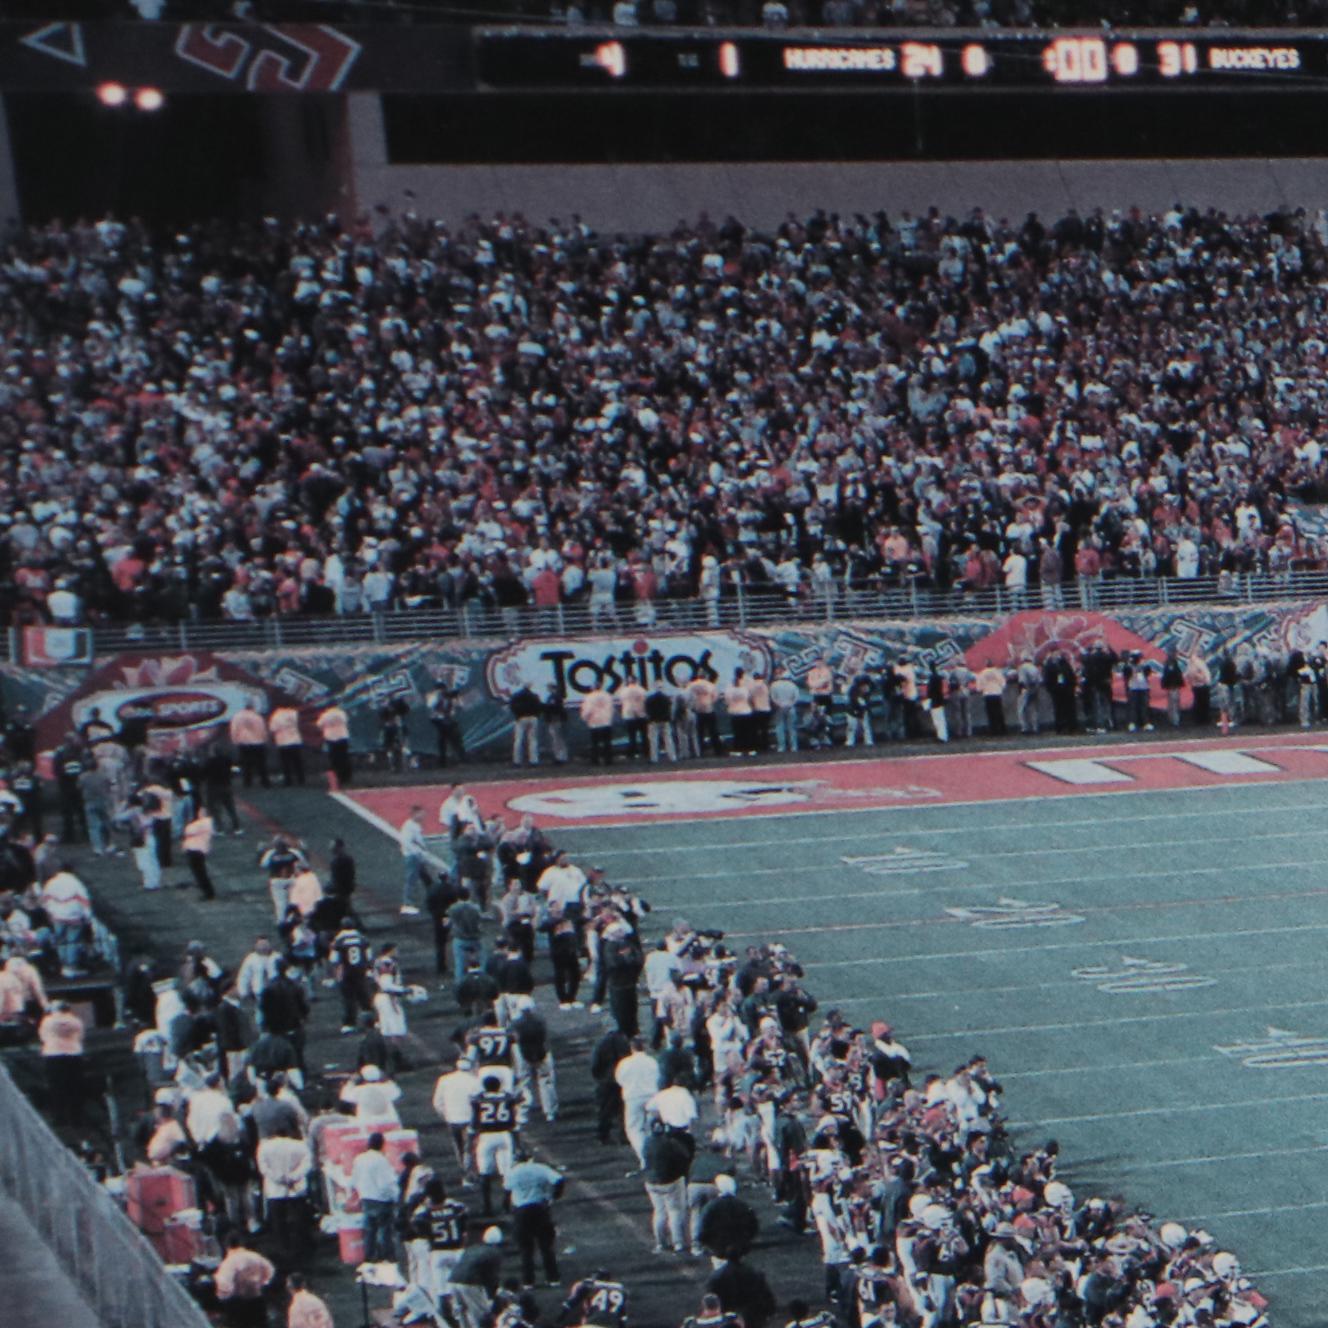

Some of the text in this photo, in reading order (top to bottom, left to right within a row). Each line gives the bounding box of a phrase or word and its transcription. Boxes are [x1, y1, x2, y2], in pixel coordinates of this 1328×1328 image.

[783, 42, 943, 77] HURRICANES 24
[1209, 47, 1301, 69] BUCKEYES
[541, 639, 716, 700] Tostitos
[479, 1036, 507, 1058] 97
[480, 1102, 510, 1123] 26
[432, 1221, 458, 1242] 51
[592, 1289, 624, 1314] 49
